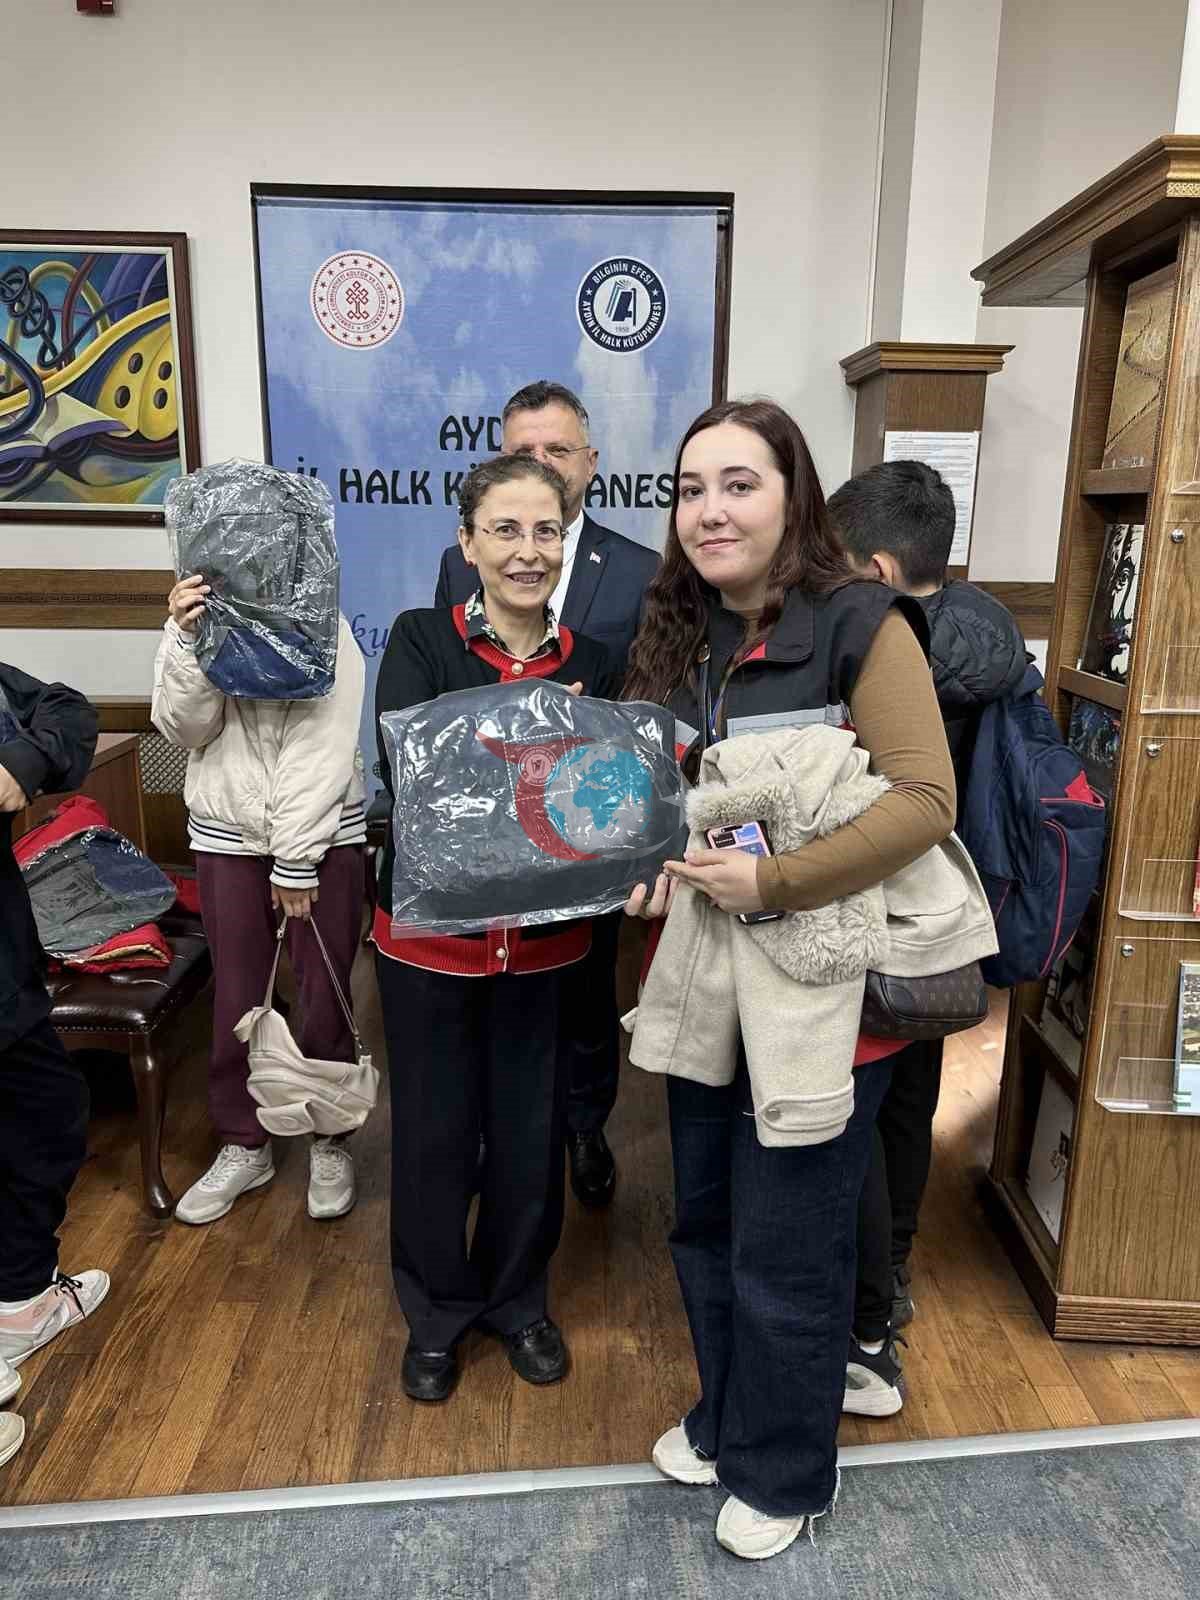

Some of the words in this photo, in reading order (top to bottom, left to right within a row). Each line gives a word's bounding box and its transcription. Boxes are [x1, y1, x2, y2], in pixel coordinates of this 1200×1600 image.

[592, 261, 628, 284] BİLGİNİN
[631, 265, 655, 285] EFESİ
[582, 300, 594, 328] AYDIN
[592, 327, 600, 337] İL
[600, 333, 621, 348] HALK
[623, 301, 662, 348] KÜTÜPHANESİ
[439, 415, 502, 451] AYD
[339, 468, 432, 505] HALK
[351, 613, 389, 658] ku
